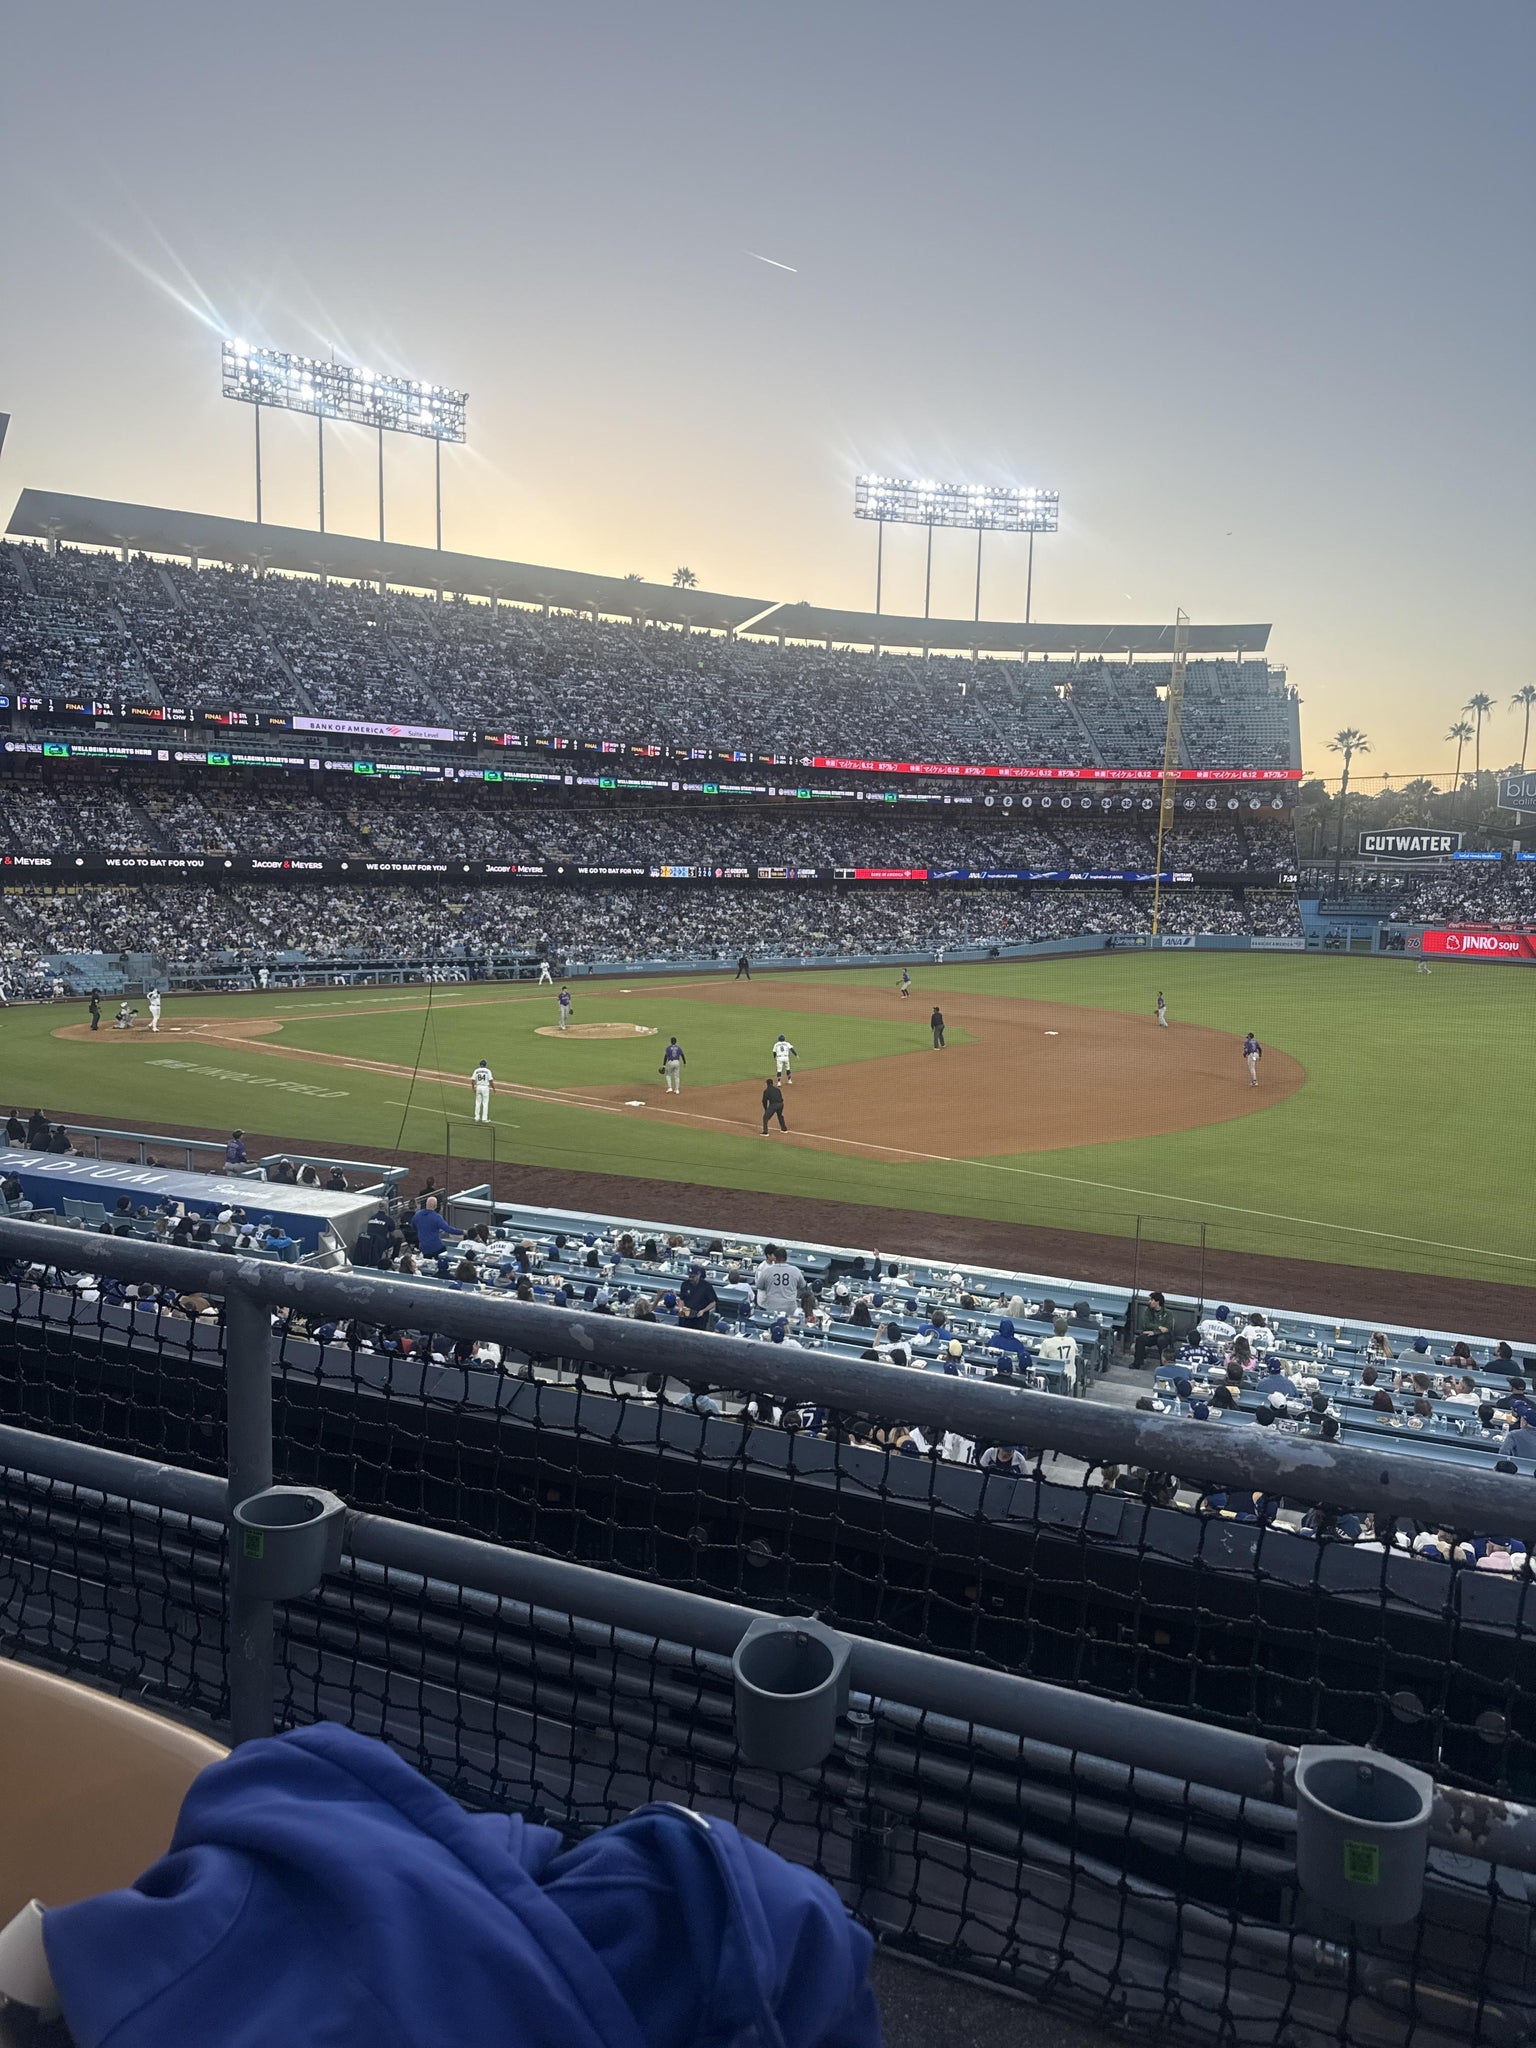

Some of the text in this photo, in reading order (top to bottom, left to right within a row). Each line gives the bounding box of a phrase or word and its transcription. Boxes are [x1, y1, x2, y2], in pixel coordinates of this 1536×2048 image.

[348, 726, 384, 734] AMERICA
[1365, 836, 1451, 851] CUTWATER
[4, 856, 51, 866] & MEYERS
[252, 860, 323, 869] JACOBY & MEYERS
[1461, 936, 1498, 952] JINRO
[264, 1082, 350, 1098] FIELD
[773, 1273, 789, 1286] 38
[1208, 1324, 1229, 1335] FREEMAN
[1057, 1345, 1071, 1359] 17
